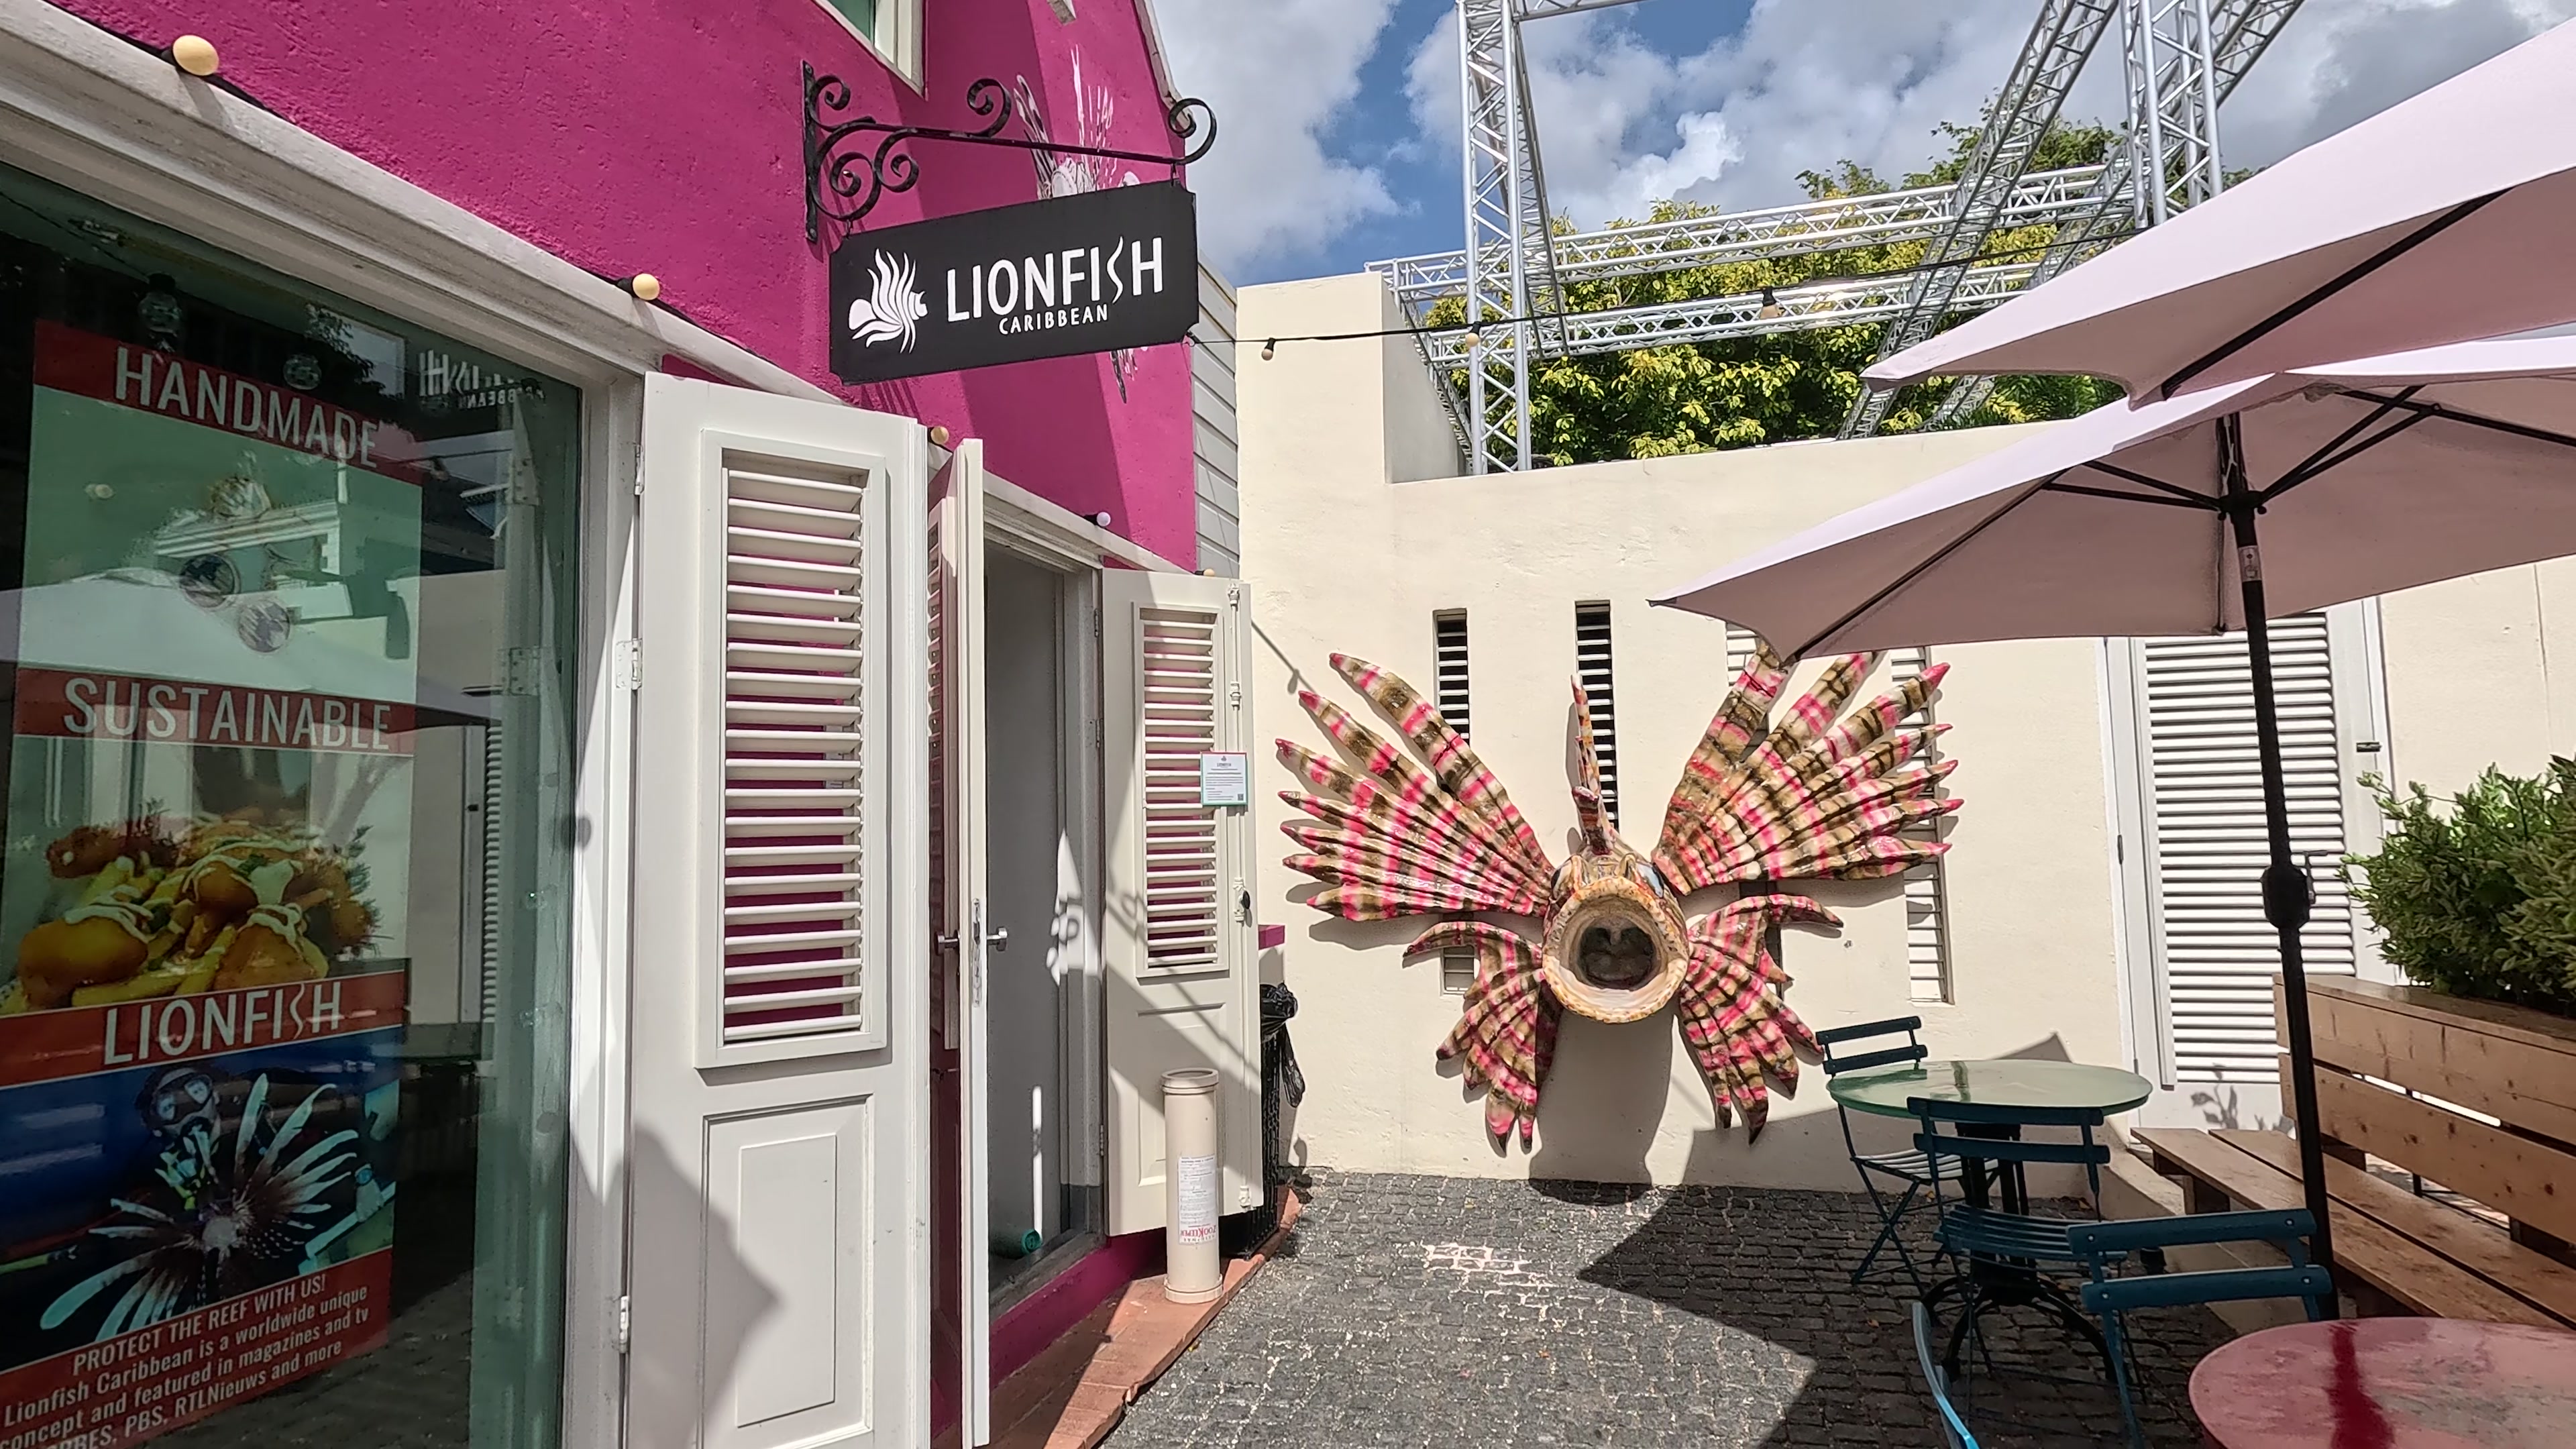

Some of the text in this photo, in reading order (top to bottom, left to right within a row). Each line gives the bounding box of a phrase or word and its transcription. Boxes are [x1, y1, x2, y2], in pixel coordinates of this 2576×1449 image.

[947, 235, 1164, 323] LIONFISH
[998, 303, 1109, 335] CARIBBEAN
[115, 346, 378, 468] HANDMADE
[64, 678, 390, 750] SUSTAINABLE
[103, 981, 343, 1065] LIONFISH
[4, 1286, 367, 1428] Lionfish Caribbean is a worldwide unique
[72, 1273, 326, 1376] PROTECT THE REEF WITH US!
[0, 1307, 369, 1449] concept and featured in magazines and tv
[175, 1370, 267, 1417] RTLNieuws
[272, 1353, 299, 1380] and
[304, 1341, 341, 1367] more
